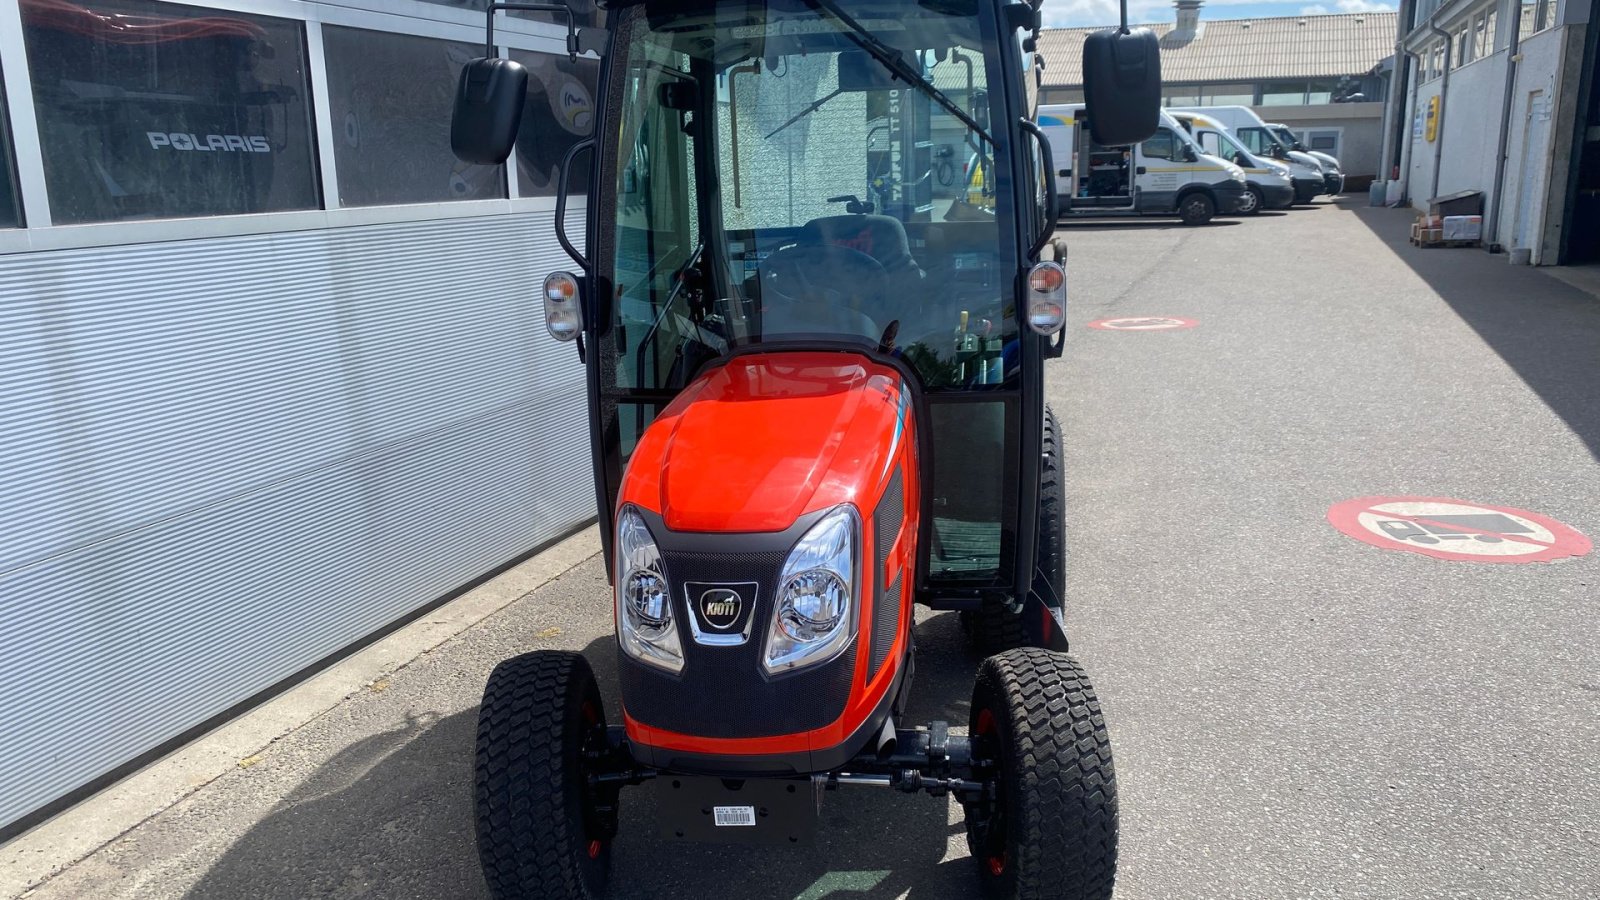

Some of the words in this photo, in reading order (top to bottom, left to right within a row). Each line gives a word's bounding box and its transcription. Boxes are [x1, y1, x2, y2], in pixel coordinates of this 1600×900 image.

[889, 89, 900, 113] 510
[890, 117, 900, 133] TT
[146, 132, 270, 152] POLARIS
[891, 141, 902, 201] TAJFUN
[706, 602, 735, 615] KIOTI
